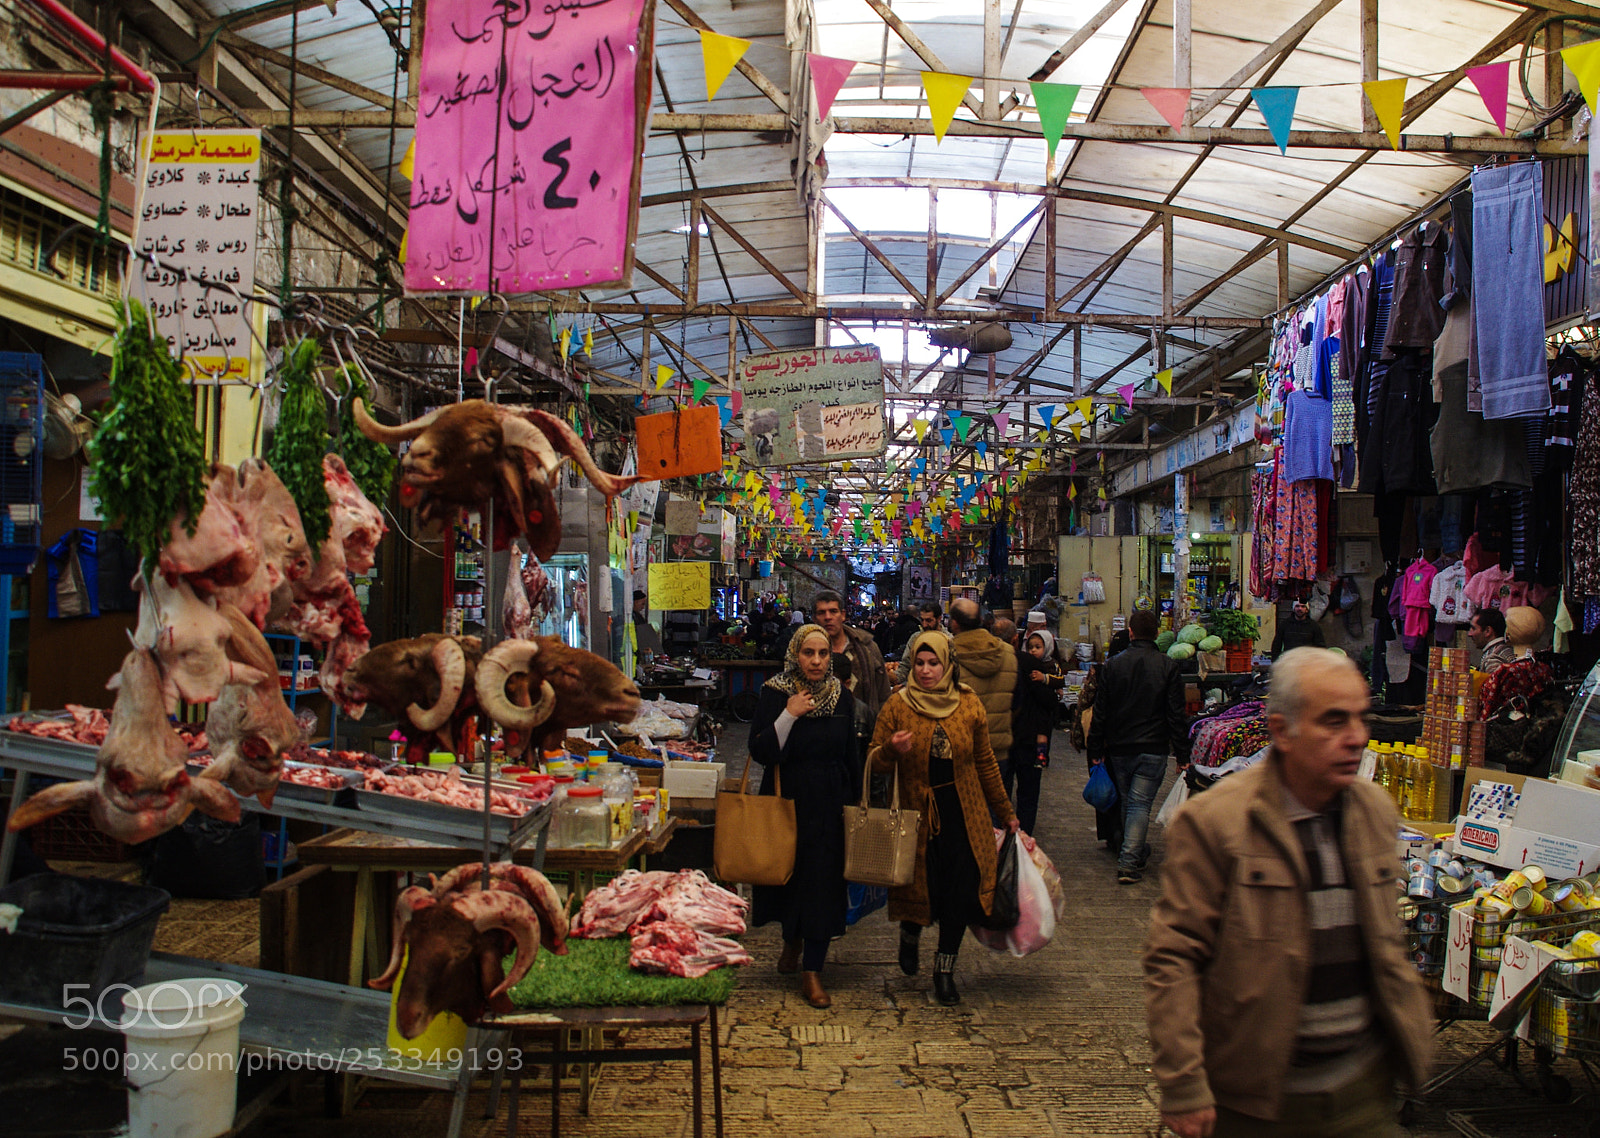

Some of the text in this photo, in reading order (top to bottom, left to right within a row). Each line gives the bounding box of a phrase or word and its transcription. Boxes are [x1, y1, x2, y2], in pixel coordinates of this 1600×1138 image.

[200, 139, 252, 158] ملحمة
[146, 168, 251, 188] كبدة كلاوي
[409, 173, 452, 210] فقط
[142, 200, 251, 221] طحال خصاوي
[143, 234, 248, 257] روس كرشات
[1462, 827, 1497, 845] AMERICANA
